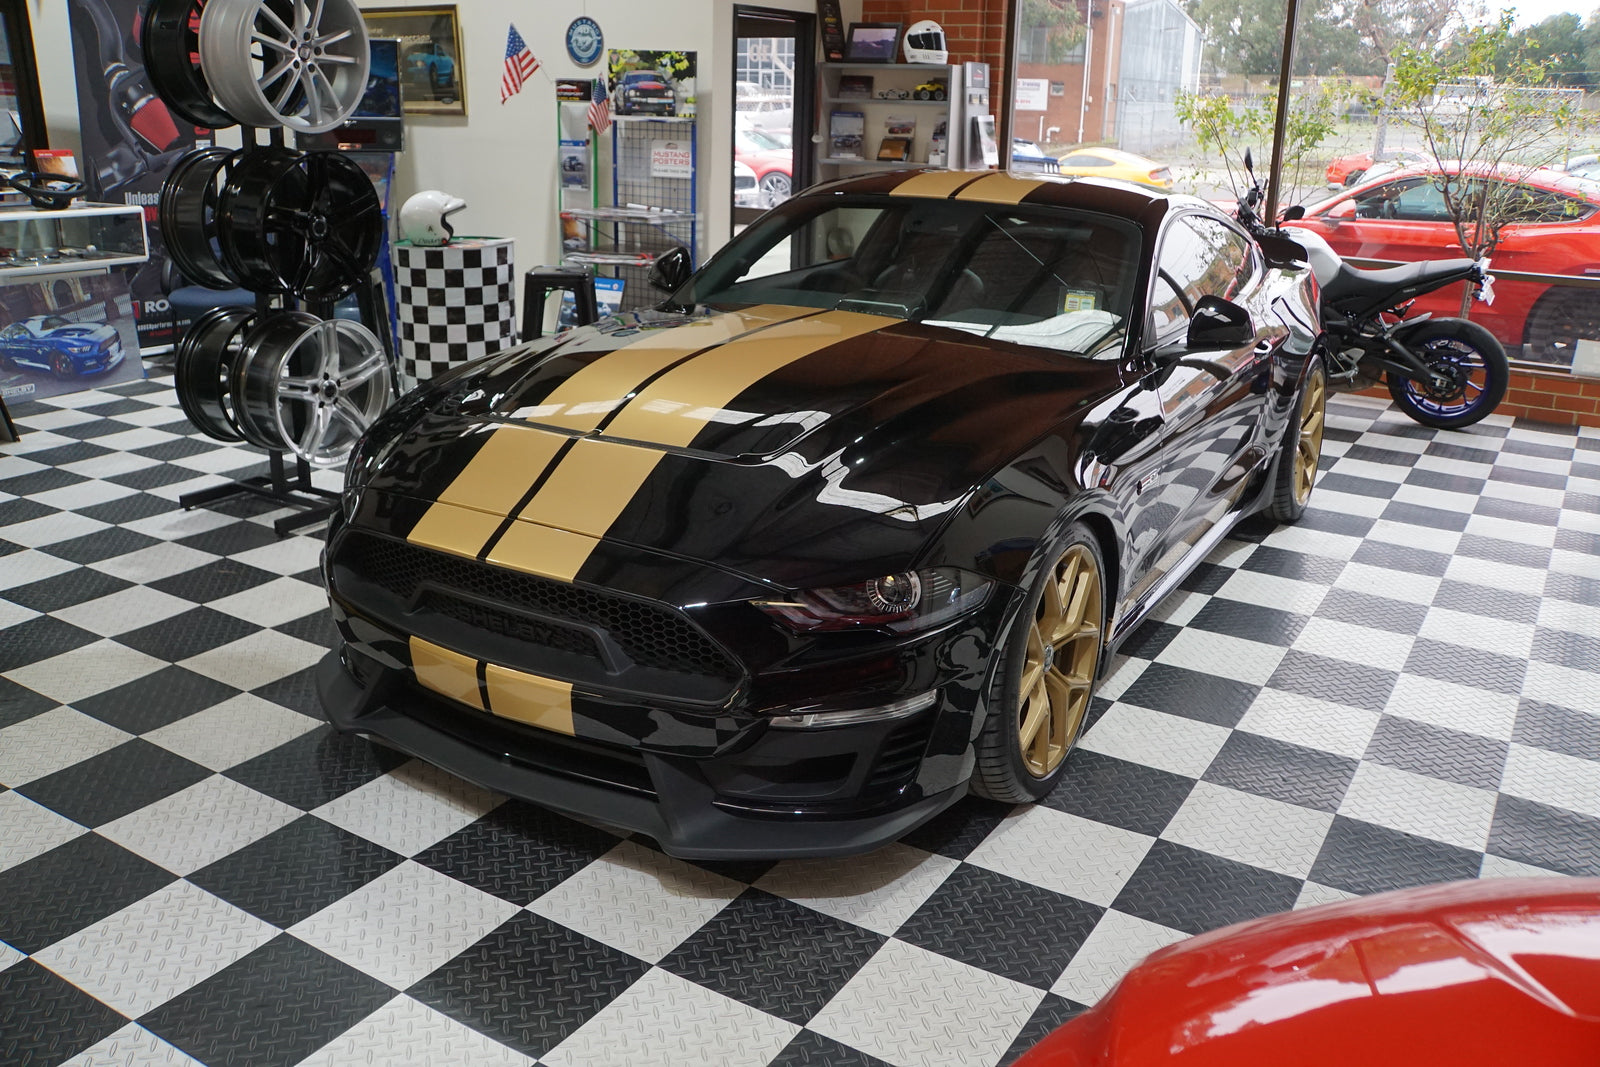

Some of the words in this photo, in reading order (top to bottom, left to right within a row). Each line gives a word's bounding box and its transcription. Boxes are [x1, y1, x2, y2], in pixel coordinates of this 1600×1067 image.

[653, 151, 690, 159] MUSTANG
[653, 158, 690, 166] POSTERS
[125, 192, 160, 205] Unleas
[455, 605, 552, 643] SHELBY
